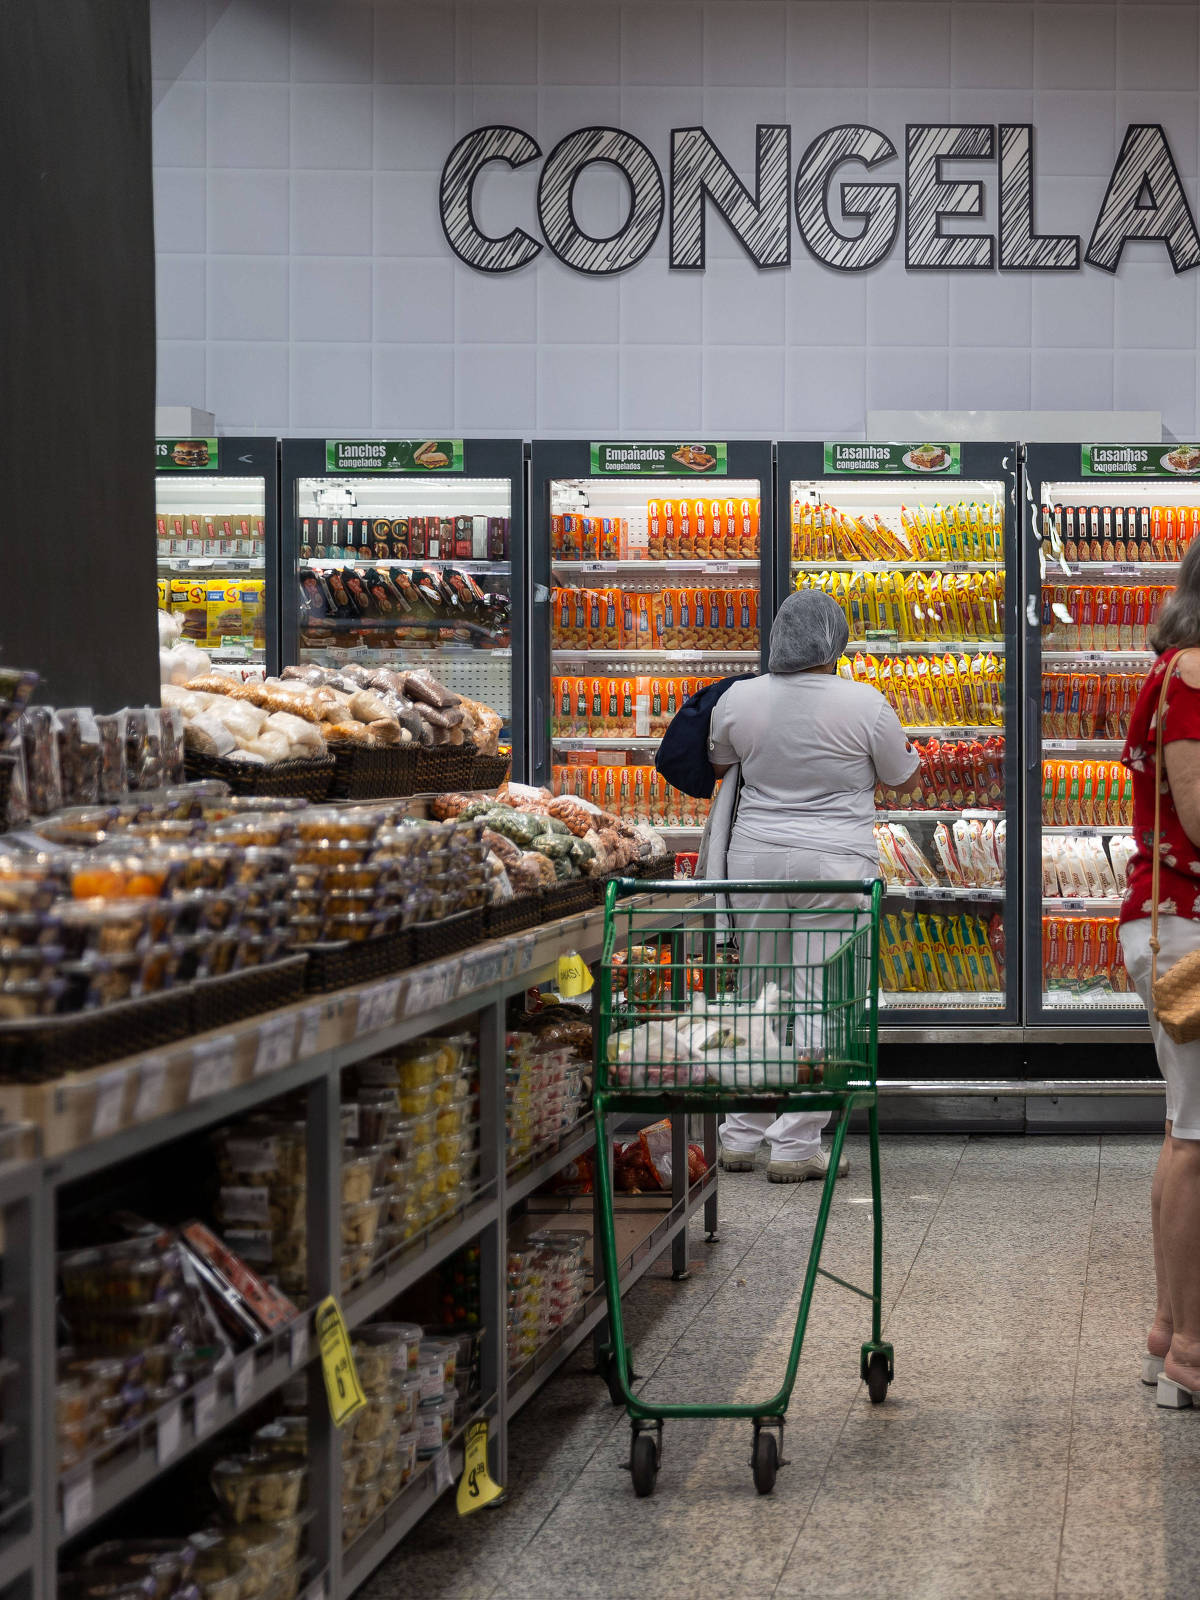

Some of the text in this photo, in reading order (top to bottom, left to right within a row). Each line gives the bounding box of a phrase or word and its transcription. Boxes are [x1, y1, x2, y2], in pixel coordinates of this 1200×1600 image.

[338, 444, 386, 457] Lanches
[605, 448, 666, 461] Empanados
[836, 446, 891, 459] Lasanhas
[1093, 448, 1148, 461] Lasanhas
[338, 458, 382, 468] congelados
[605, 462, 641, 470] Congelados
[836, 460, 879, 469] congeladas
[468, 1467, 479, 1498] 9
